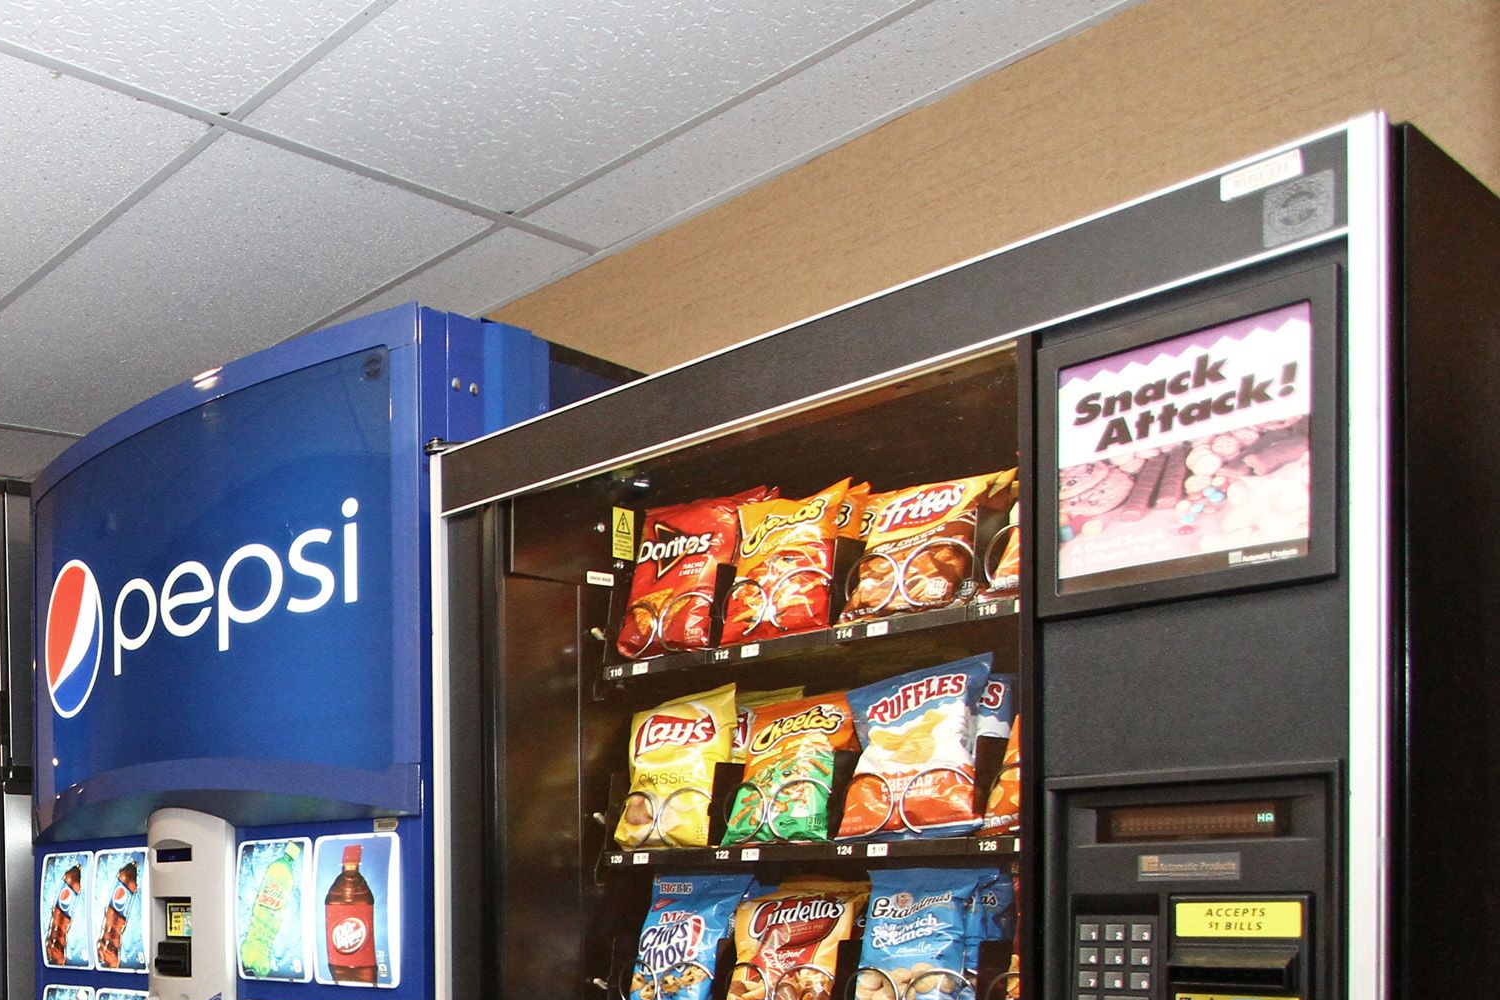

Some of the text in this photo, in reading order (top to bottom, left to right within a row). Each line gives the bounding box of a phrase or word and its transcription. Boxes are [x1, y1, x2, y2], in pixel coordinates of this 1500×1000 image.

[1073, 354, 1228, 426] Snack
[1095, 361, 1297, 452] Attack!
[877, 483, 965, 533] Fritos
[637, 533, 712, 564] Doritos
[113, 497, 359, 676] pepsi
[977, 605, 997, 616] 116
[836, 628, 853, 639] 114
[715, 651, 729, 660] 112
[610, 669, 623, 677] 110
[868, 673, 966, 723] RUFFLES
[750, 704, 843, 754] Cheetos
[634, 716, 714, 759] Lay's
[837, 846, 853, 855] 124
[979, 841, 997, 851] 126
[610, 855, 623, 864] 120
[715, 850, 730, 860] 122
[1205, 907, 1266, 917] ACCEPTS
[1225, 922, 1263, 931] BILLS
[640, 922, 689, 952] Chips
[1090, 931, 1096, 940] 1
[1115, 931, 1123, 940] 2
[1141, 932, 1149, 940] 3
[1088, 955, 1096, 963] 4
[1115, 955, 1122, 963] 5
[1141, 956, 1148, 964] 6
[1088, 979, 1095, 987] 7
[1114, 980, 1122, 988] 8
[1140, 980, 1147, 988] 9
